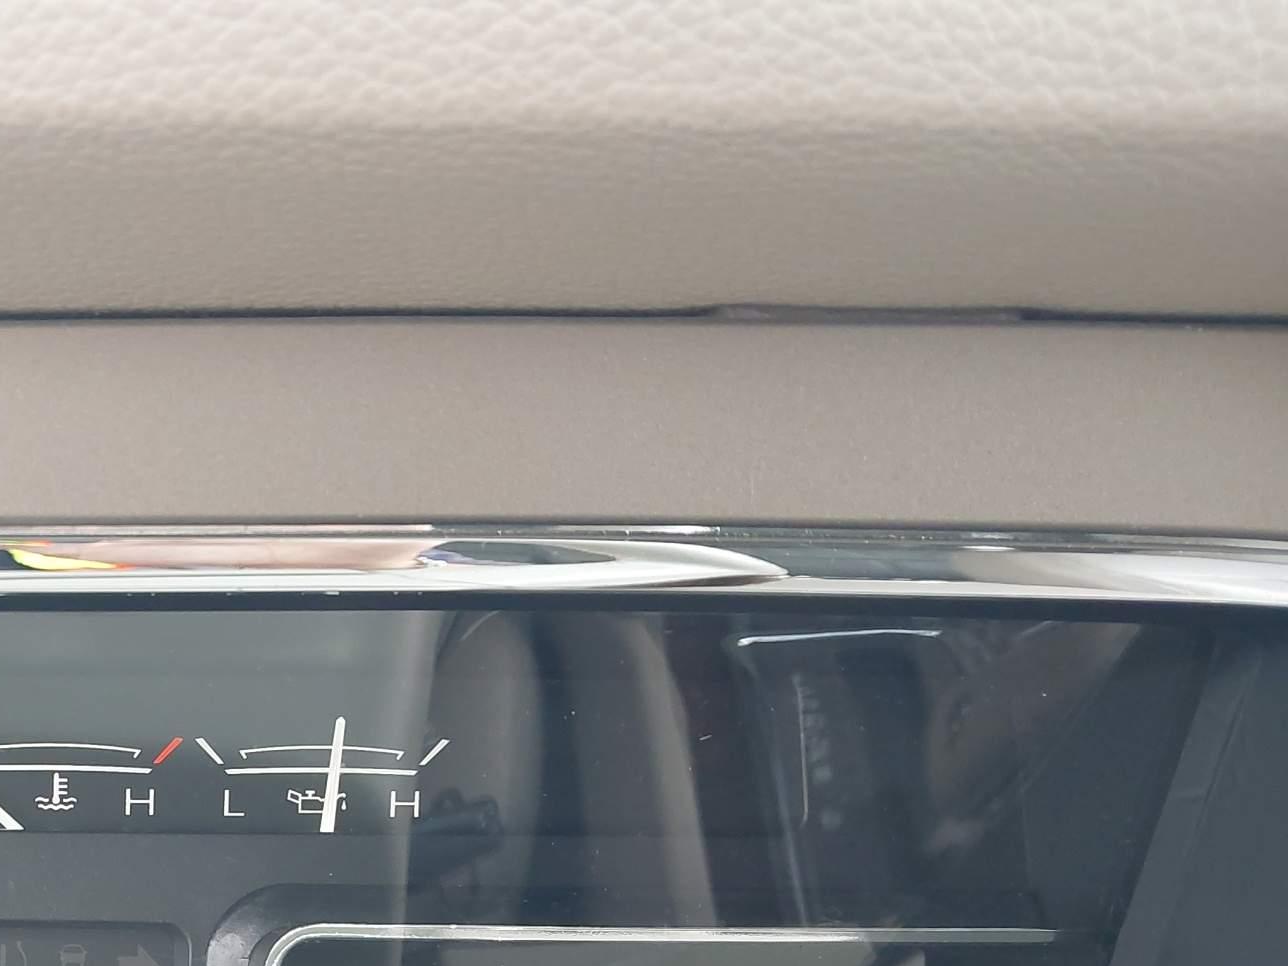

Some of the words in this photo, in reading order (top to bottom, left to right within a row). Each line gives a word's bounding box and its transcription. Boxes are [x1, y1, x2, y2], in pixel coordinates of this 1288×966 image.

[125, 788, 155, 816] H
[223, 789, 245, 817] L
[389, 790, 420, 818] H
